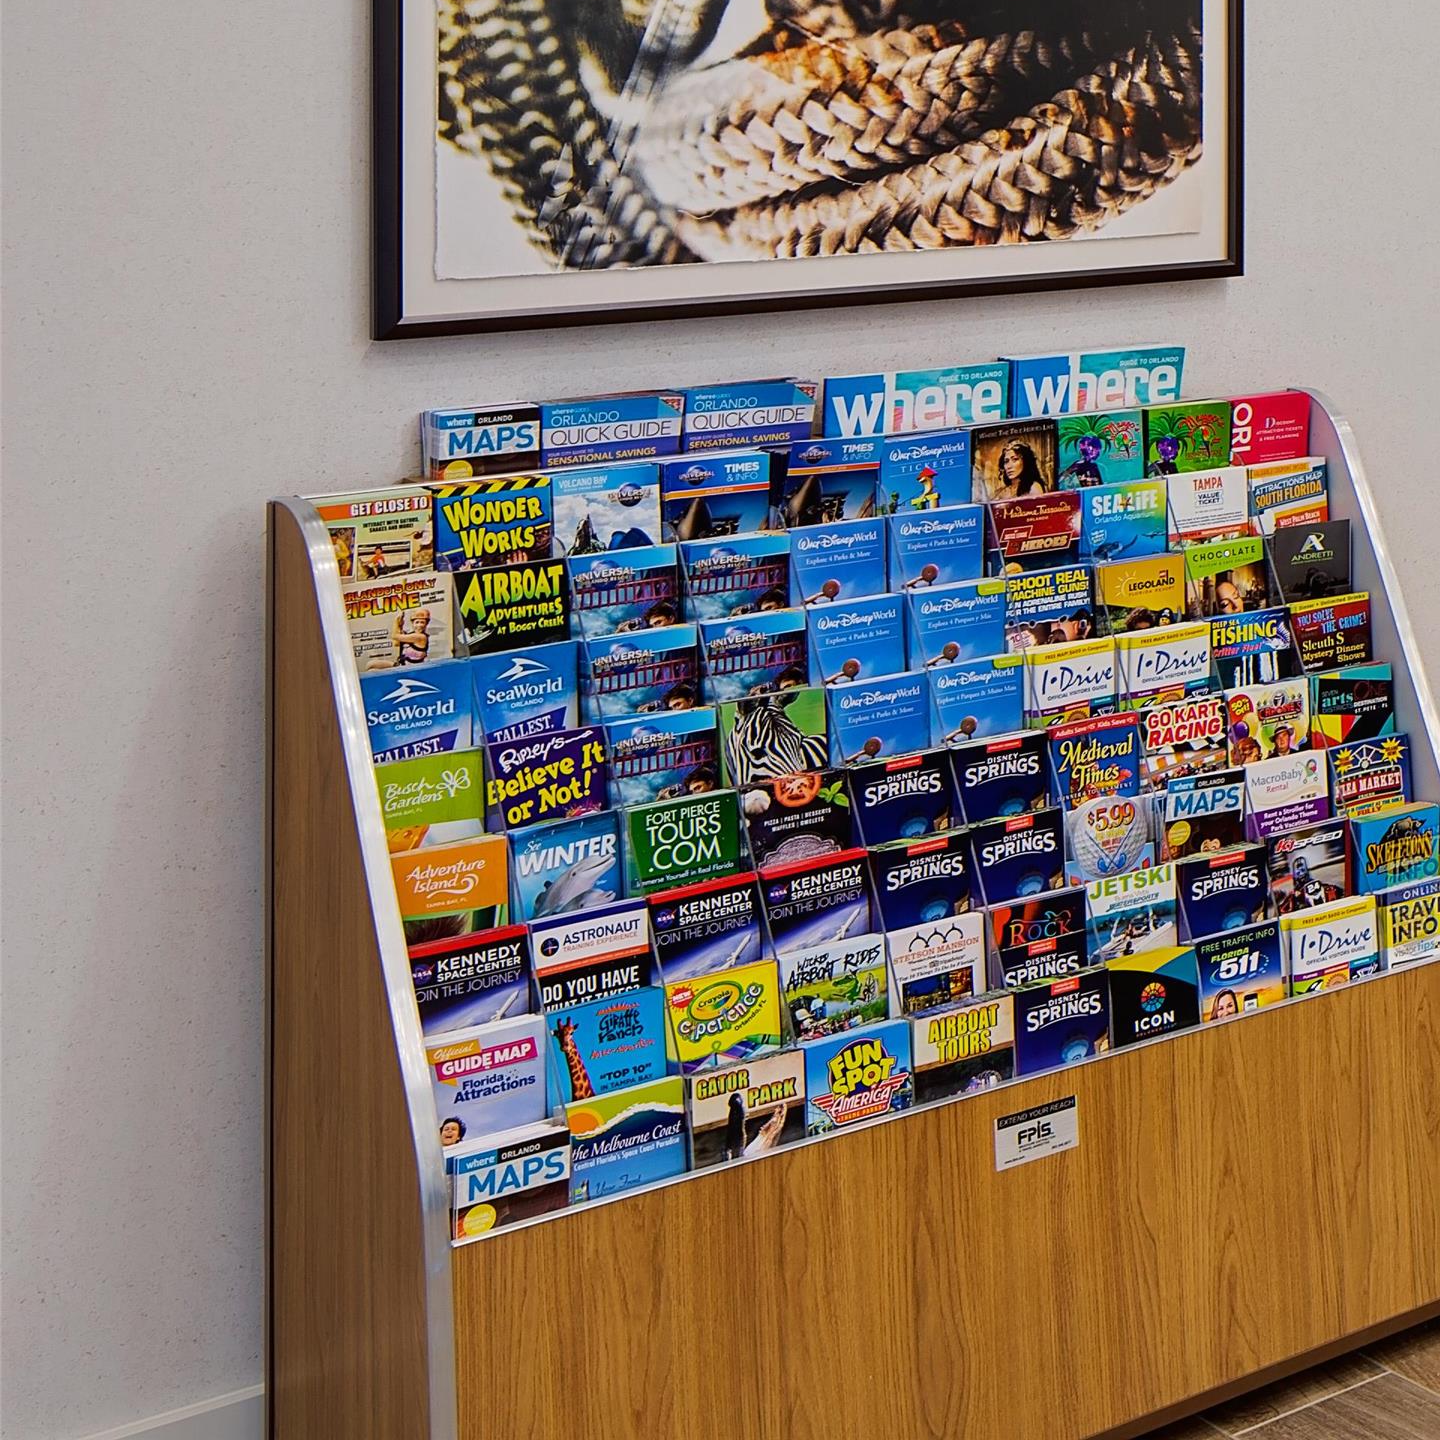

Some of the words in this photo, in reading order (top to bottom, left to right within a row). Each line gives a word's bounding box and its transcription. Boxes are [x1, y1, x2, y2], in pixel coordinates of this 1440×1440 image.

[694, 397, 758, 412] ORLANDO
[1023, 363, 1177, 420] where
[446, 417, 473, 428] where
[478, 414, 513, 424] ORLANDO
[551, 410, 620, 427] ORLANDO
[693, 412, 749, 430] QUICK
[752, 407, 806, 425] GUIDE
[833, 379, 1002, 438] where
[448, 424, 534, 456] MAPS
[550, 425, 612, 447] QUICK
[614, 420, 672, 439] GUIDE
[689, 439, 750, 449] SENSATIONAL
[752, 432, 790, 443] SAVINGS
[842, 442, 874, 453] TIMES
[547, 450, 614, 467] SENSATIONAL
[615, 447, 657, 459] SAVINGS
[724, 461, 760, 472] TIMES
[1192, 475, 1223, 490] TAMPA
[1197, 491, 1221, 502] VALUE
[1255, 491, 1284, 509] SOUTH
[1284, 479, 1323, 500] FLORIDA
[350, 502, 371, 517] GET
[373, 498, 410, 515] CLOSE
[412, 496, 428, 509] TO
[443, 495, 543, 532] WONDER
[1197, 497, 1221, 506] TICKET
[1094, 512, 1121, 525] Orlando
[1122, 509, 1156, 523] Aquarium
[460, 524, 536, 558] WORKS
[1192, 544, 1257, 562] CHOCOLATE
[1290, 549, 1334, 562] ANDRETTI
[460, 564, 564, 620] AIRBOAT
[1008, 573, 1052, 592] SHOOT
[1055, 568, 1089, 585] REAL
[1128, 576, 1176, 592] LEGOLAND
[486, 597, 564, 626] ADVENTURES
[497, 625, 506, 636] AT
[508, 620, 537, 633] BOGGY
[538, 615, 565, 629] CREEK
[1212, 620, 1278, 648] FISHING
[1303, 647, 1334, 662] Mystery
[1335, 641, 1365, 655] Dinner
[1337, 650, 1366, 663] Shows
[486, 677, 563, 705] SeaWorld
[511, 696, 544, 709] ORLANDO
[1047, 693, 1068, 702] OFFICIAL
[1068, 689, 1090, 699] VISITORS
[1091, 684, 1108, 694] GUIDE
[1321, 692, 1354, 707] arts
[367, 698, 455, 727] SeaWorld
[394, 718, 433, 731] ORLANDO
[1147, 709, 1172, 729] GO
[1174, 701, 1220, 723] KART
[1147, 717, 1222, 748] RACING
[986, 751, 1019, 766] DISNEY
[1059, 731, 1134, 774] Medieval
[486, 753, 575, 807] Believe
[582, 740, 606, 770] It
[886, 769, 920, 784] DISNEY
[964, 755, 1042, 789] SPRINGS
[1071, 758, 1120, 792] Times
[384, 776, 434, 799] Busch
[384, 789, 443, 813] Gardens
[507, 801, 533, 825] or
[538, 768, 598, 813] Not!
[864, 772, 944, 808] SPRINGS
[1173, 785, 1240, 818] MAPS
[1266, 783, 1289, 793] Rental
[646, 808, 677, 827] FORT
[680, 800, 721, 819] PIERCE
[1087, 801, 1136, 833] $5.99
[1260, 820, 1273, 830] your
[1274, 814, 1297, 826] Orlando
[1298, 809, 1319, 819] Theme
[1263, 810, 1278, 819] Rent
[1283, 804, 1306, 816] Stroller
[1306, 802, 1315, 811] for
[646, 814, 722, 847] TOURS
[1002, 828, 1035, 843] DISNEY
[520, 833, 617, 875] WINTER
[648, 835, 722, 873] .COM
[909, 853, 943, 868] DISNEY
[982, 832, 1058, 868] SPRINGS
[1366, 831, 1433, 874] SKELETONS
[405, 858, 486, 882] Adventure
[666, 869, 690, 882] Yourself
[690, 869, 698, 878] in
[698, 866, 712, 876] Real
[712, 860, 735, 872] Florida
[790, 863, 862, 891] KENNEDY
[886, 855, 966, 891] SPRINGS
[1089, 864, 1172, 901] JETSKI
[1211, 865, 1242, 880] DISNEY
[413, 876, 459, 894] Island
[790, 885, 823, 901] SPACE
[823, 875, 862, 894] CENTER
[1191, 868, 1260, 901] SPRINGS
[678, 889, 753, 916] KENNEDY
[679, 910, 713, 927] SPACE
[713, 900, 753, 920] CENTER
[768, 906, 794, 922] JOIN
[796, 901, 815, 917] THE
[815, 888, 863, 912] JOURNEY
[562, 917, 641, 946] ASTRONAUT
[655, 931, 682, 946] JOIN
[683, 925, 704, 940] THE
[702, 913, 753, 936] JOURNEY
[1200, 940, 1221, 955] FREE
[1221, 933, 1254, 949] TRAFFIC
[1254, 927, 1275, 940] INFO
[1391, 917, 1439, 944] INFO
[437, 942, 521, 973] KENNEDY
[1025, 953, 1058, 968] DISNEY
[1211, 946, 1250, 964] FLORIDA
[1218, 950, 1261, 979] 511
[1306, 955, 1328, 966] OFFICIAL
[1328, 950, 1351, 962] VISITORS
[1351, 945, 1367, 956] GUIDE
[437, 967, 476, 983] SPACE
[475, 956, 522, 976] CENTER
[1004, 954, 1081, 987] SPRINGS
[542, 984, 565, 1004] DO
[565, 974, 598, 998] YOU
[600, 964, 641, 989] HAVE
[1026, 993, 1104, 1032] SPRINGS
[1048, 992, 1081, 1007] DISNEY
[928, 1002, 1001, 1044] AIRBOAT
[1134, 1009, 1176, 1034] ICON
[441, 1051, 493, 1077] GUIDE
[494, 1042, 532, 1065] MAP
[829, 1040, 884, 1080] FUN
[935, 1029, 992, 1065] TOURS
[453, 1074, 537, 1105] Attractions
[462, 1072, 504, 1091] Florida
[697, 1068, 750, 1101] GATOR
[832, 1056, 896, 1098] SPOT
[747, 1075, 798, 1109] PARK
[829, 1085, 892, 1118] AMERICA
[998, 1112, 1029, 1128] EXTEND
[1028, 1106, 1050, 1119] YOUR
[1049, 1098, 1075, 1112] REACH
[572, 1146, 590, 1162] the
[590, 1131, 648, 1160] Melbourne
[650, 1120, 682, 1141] Coast
[465, 1155, 496, 1170] where
[500, 1142, 541, 1161] ORLANDO
[467, 1150, 566, 1203] MAPS
